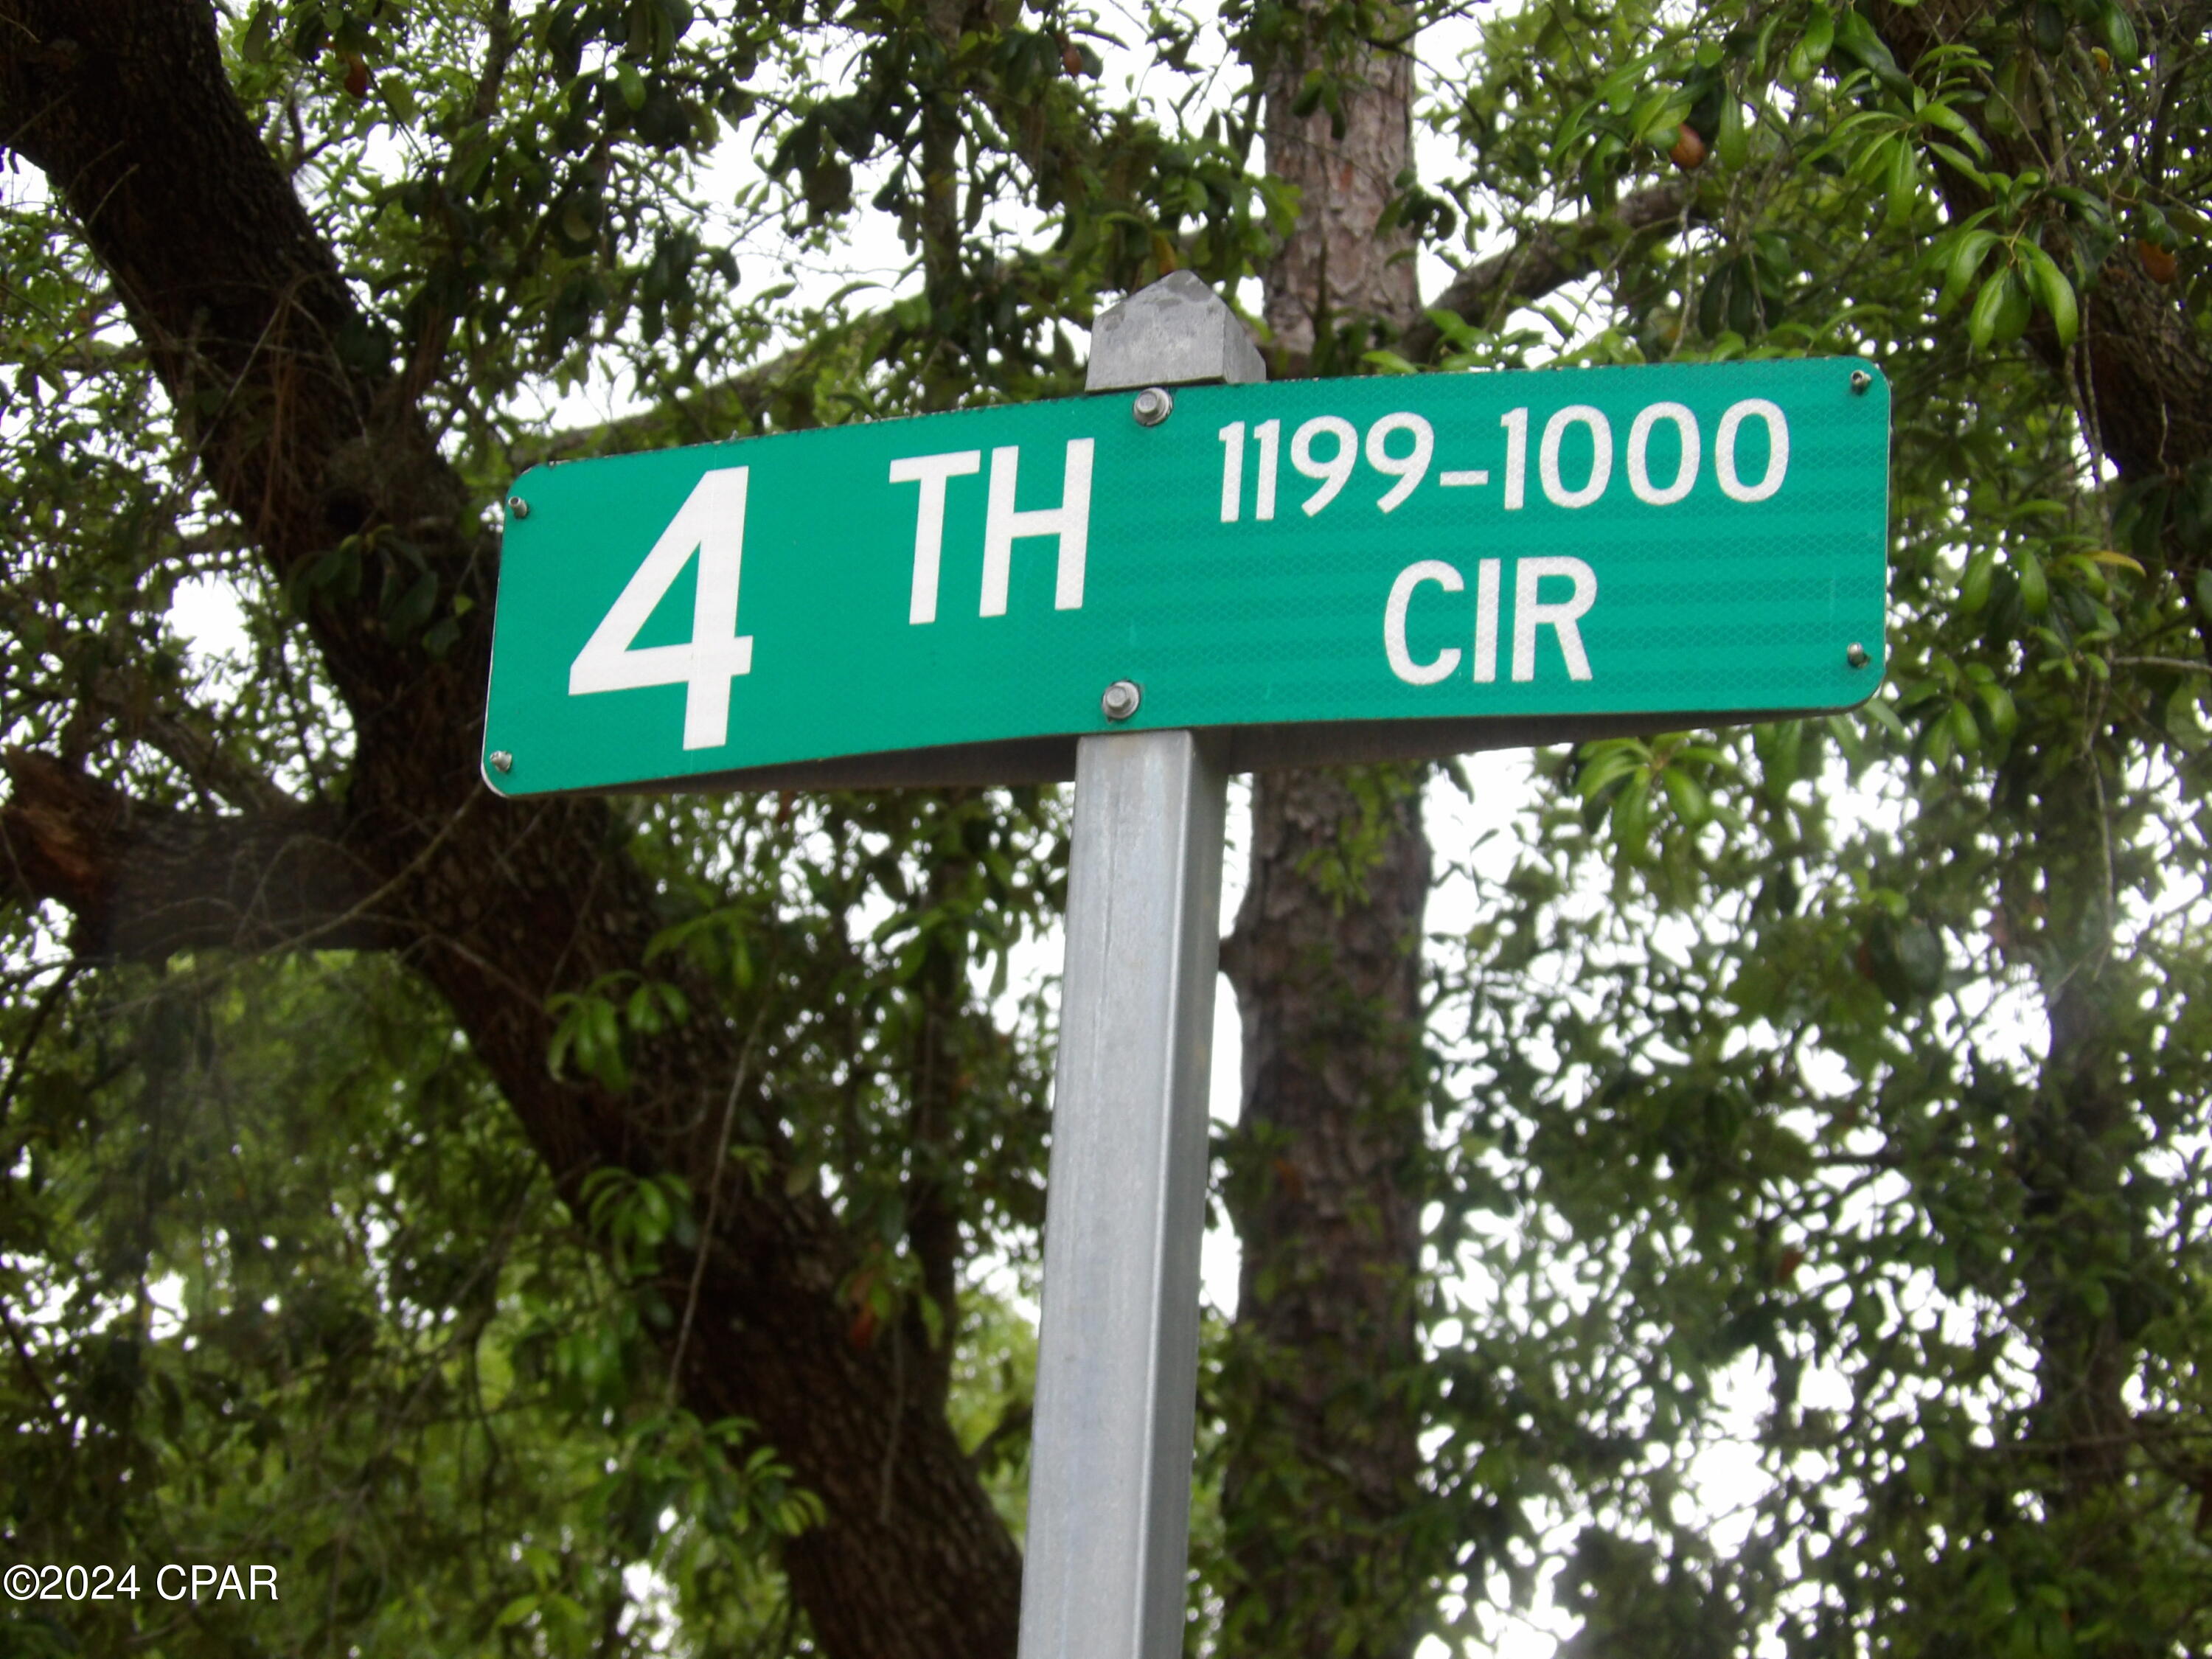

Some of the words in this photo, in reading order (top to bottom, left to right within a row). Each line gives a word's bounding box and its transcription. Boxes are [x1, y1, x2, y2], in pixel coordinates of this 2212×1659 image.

[1218, 399, 1790, 523] 1199-1000
[568, 466, 754, 751] 4
[889, 437, 1095, 625] TH
[1384, 556, 1598, 686] CIR
